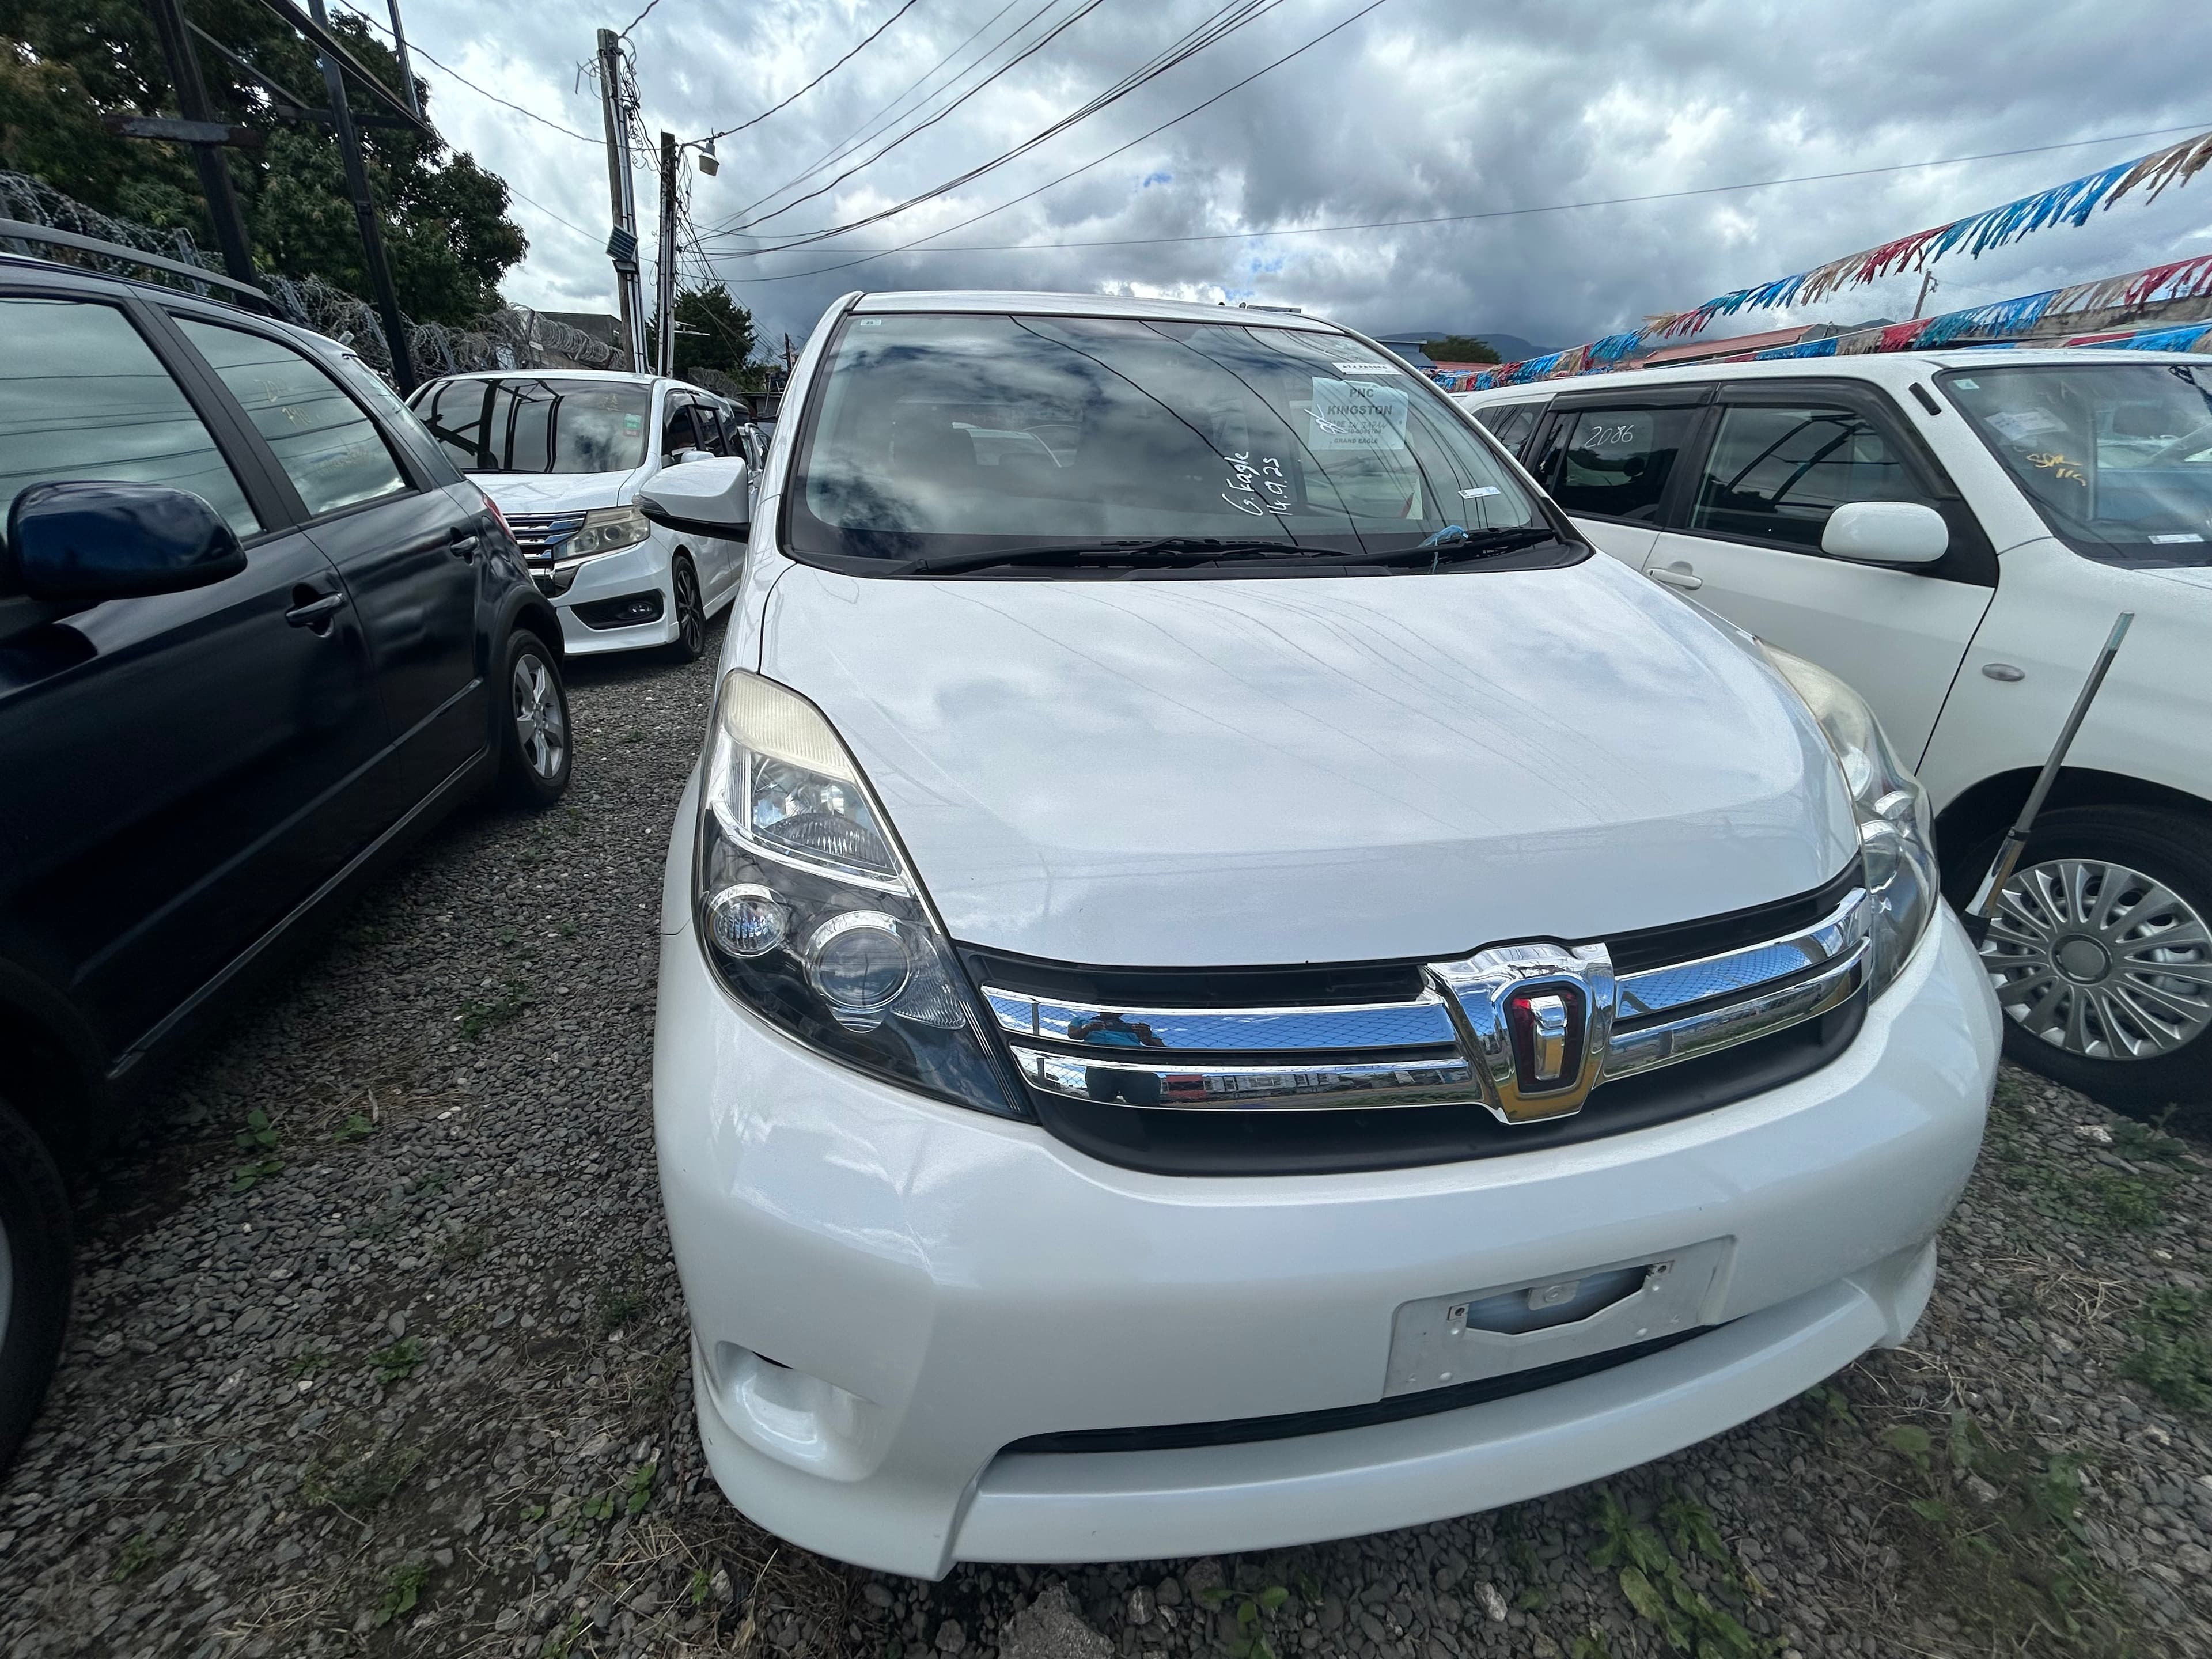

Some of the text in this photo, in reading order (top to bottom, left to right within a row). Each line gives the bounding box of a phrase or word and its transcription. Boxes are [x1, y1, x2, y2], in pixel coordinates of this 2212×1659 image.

[1349, 388, 1374, 398] PNC
[1327, 405, 1393, 415] KINGSTON
[1584, 424, 1635, 448] 2086
